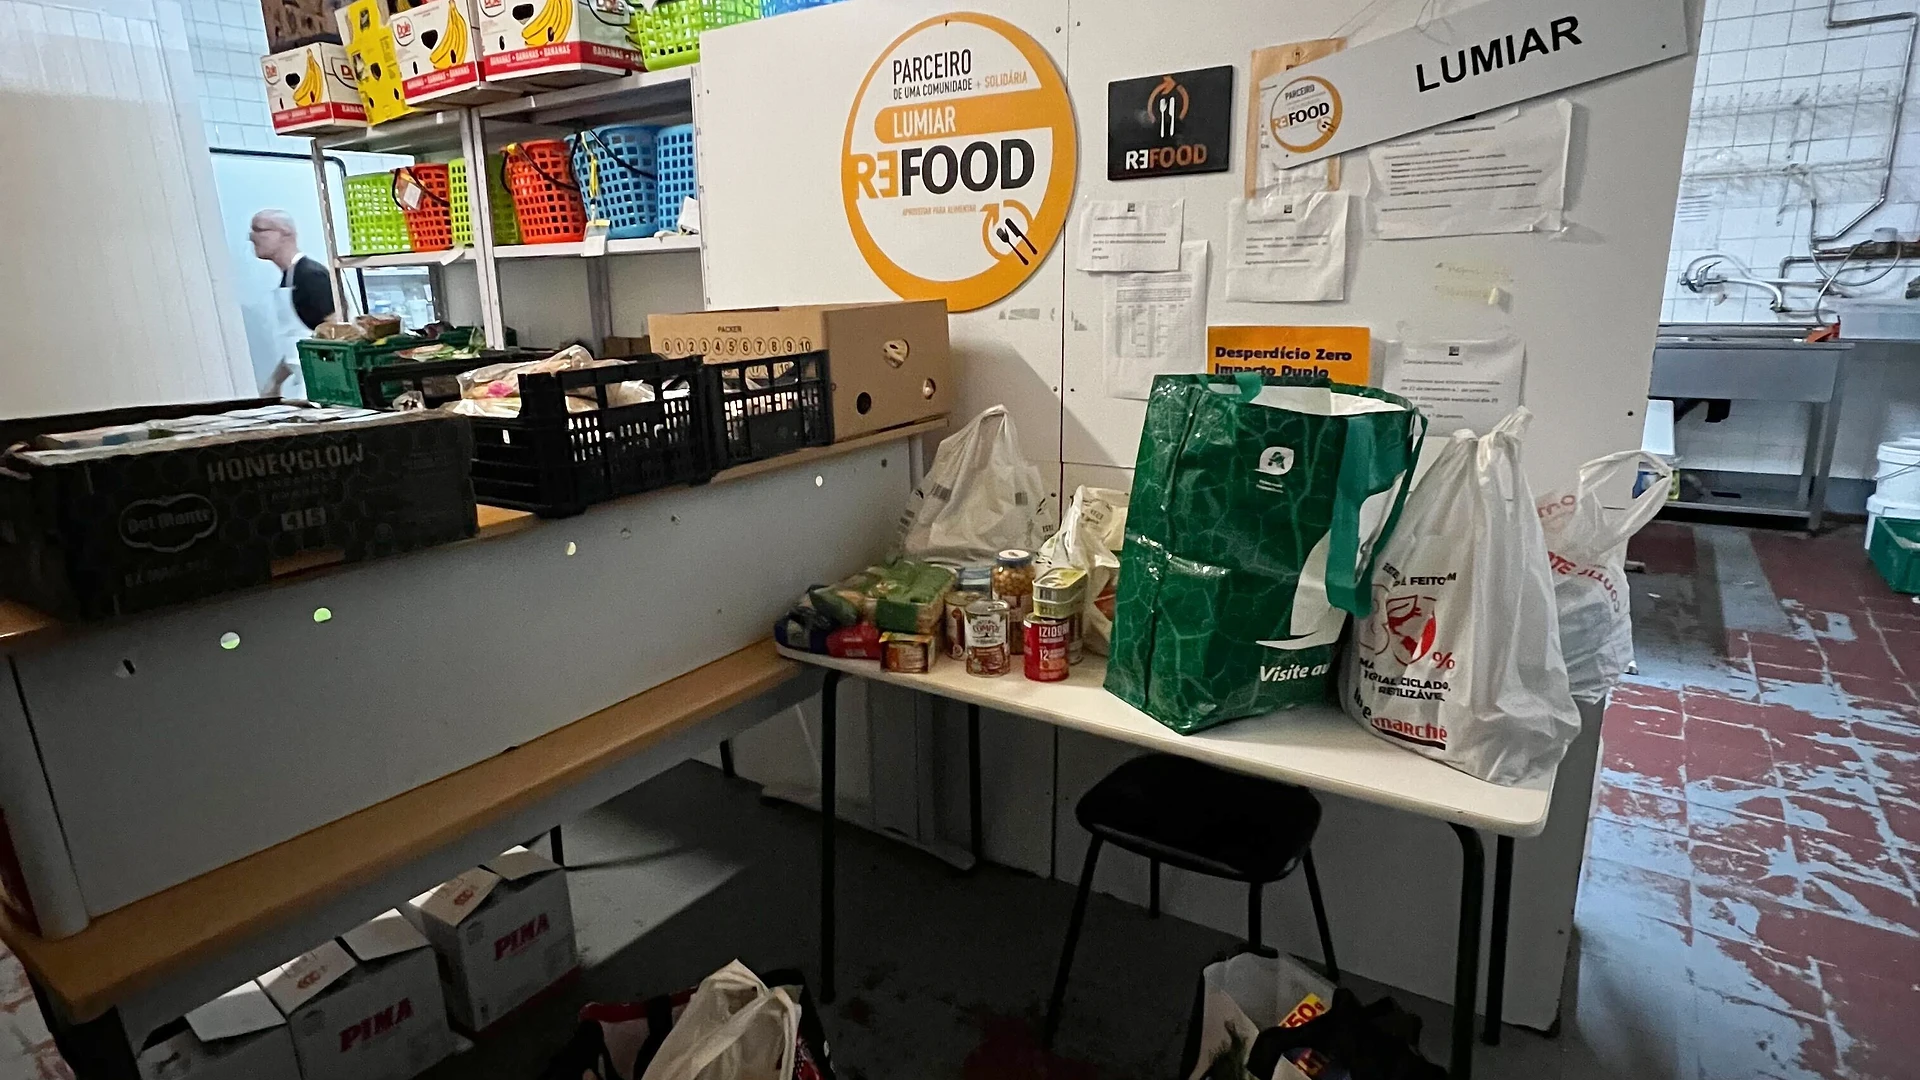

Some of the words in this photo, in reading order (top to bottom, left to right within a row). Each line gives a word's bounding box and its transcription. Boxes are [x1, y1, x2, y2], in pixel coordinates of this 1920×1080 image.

[893, 49, 972, 84] PARCEIRO
[1415, 16, 1582, 92] LUMIAR
[893, 87, 902, 100] DE
[904, 85, 921, 98] UMA
[922, 78, 973, 96] COMUNIDADE
[985, 69, 1028, 88] SOLIDÁRIA
[893, 106, 956, 138] LUMIAR
[1215, 346, 1311, 361] Desperdício
[1315, 348, 1352, 361] Zero
[207, 442, 364, 483] HONEYGLOW
[1260, 664, 1309, 681] Visite
[339, 997, 415, 1053] PIMA
